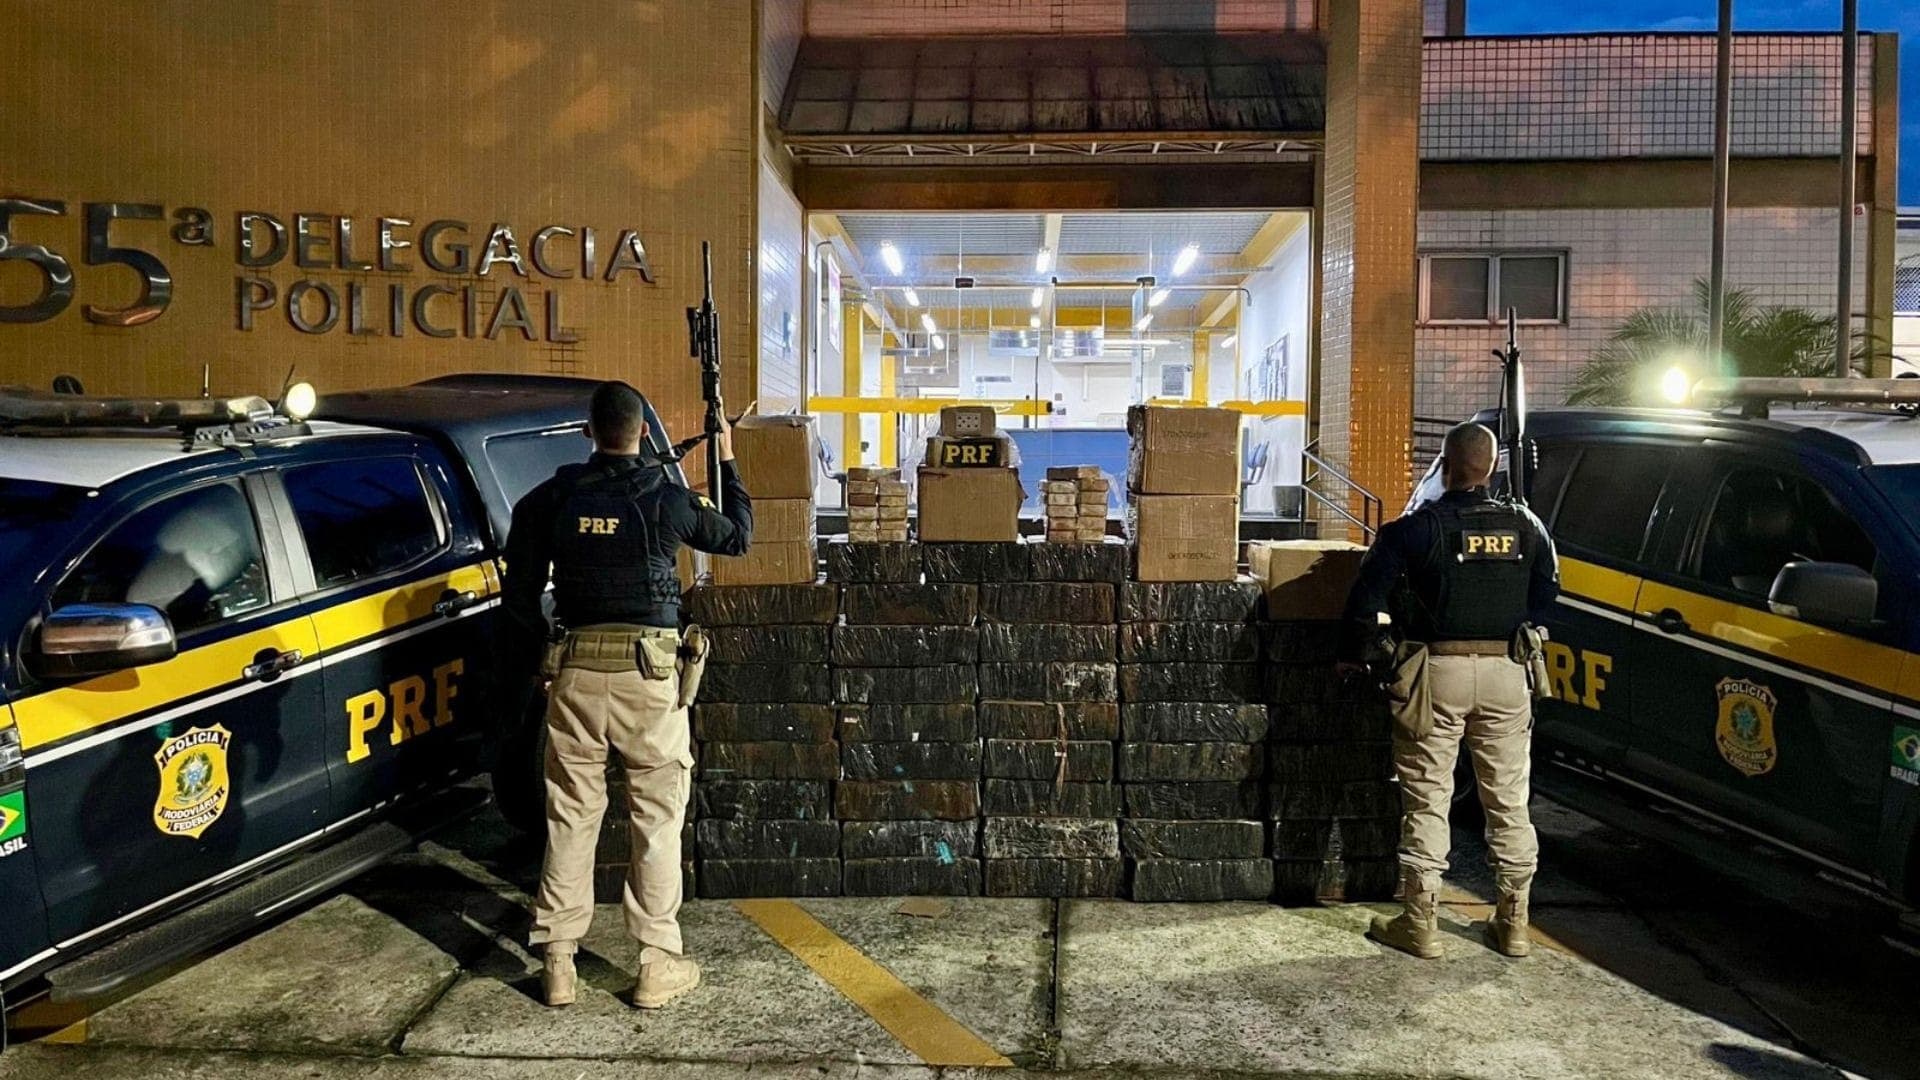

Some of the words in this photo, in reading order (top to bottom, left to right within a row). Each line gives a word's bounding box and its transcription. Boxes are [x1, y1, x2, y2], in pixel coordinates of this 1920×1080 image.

[236, 212, 656, 284] DELEGACIA
[235, 275, 579, 344] POLICIAL
[944, 444, 993, 464] PRF
[578, 516, 619, 535] PRF
[1467, 535, 1514, 553] PRF
[1541, 641, 1613, 711] RF
[346, 658, 464, 764] PRF
[173, 811, 215, 831] FEDERAL
